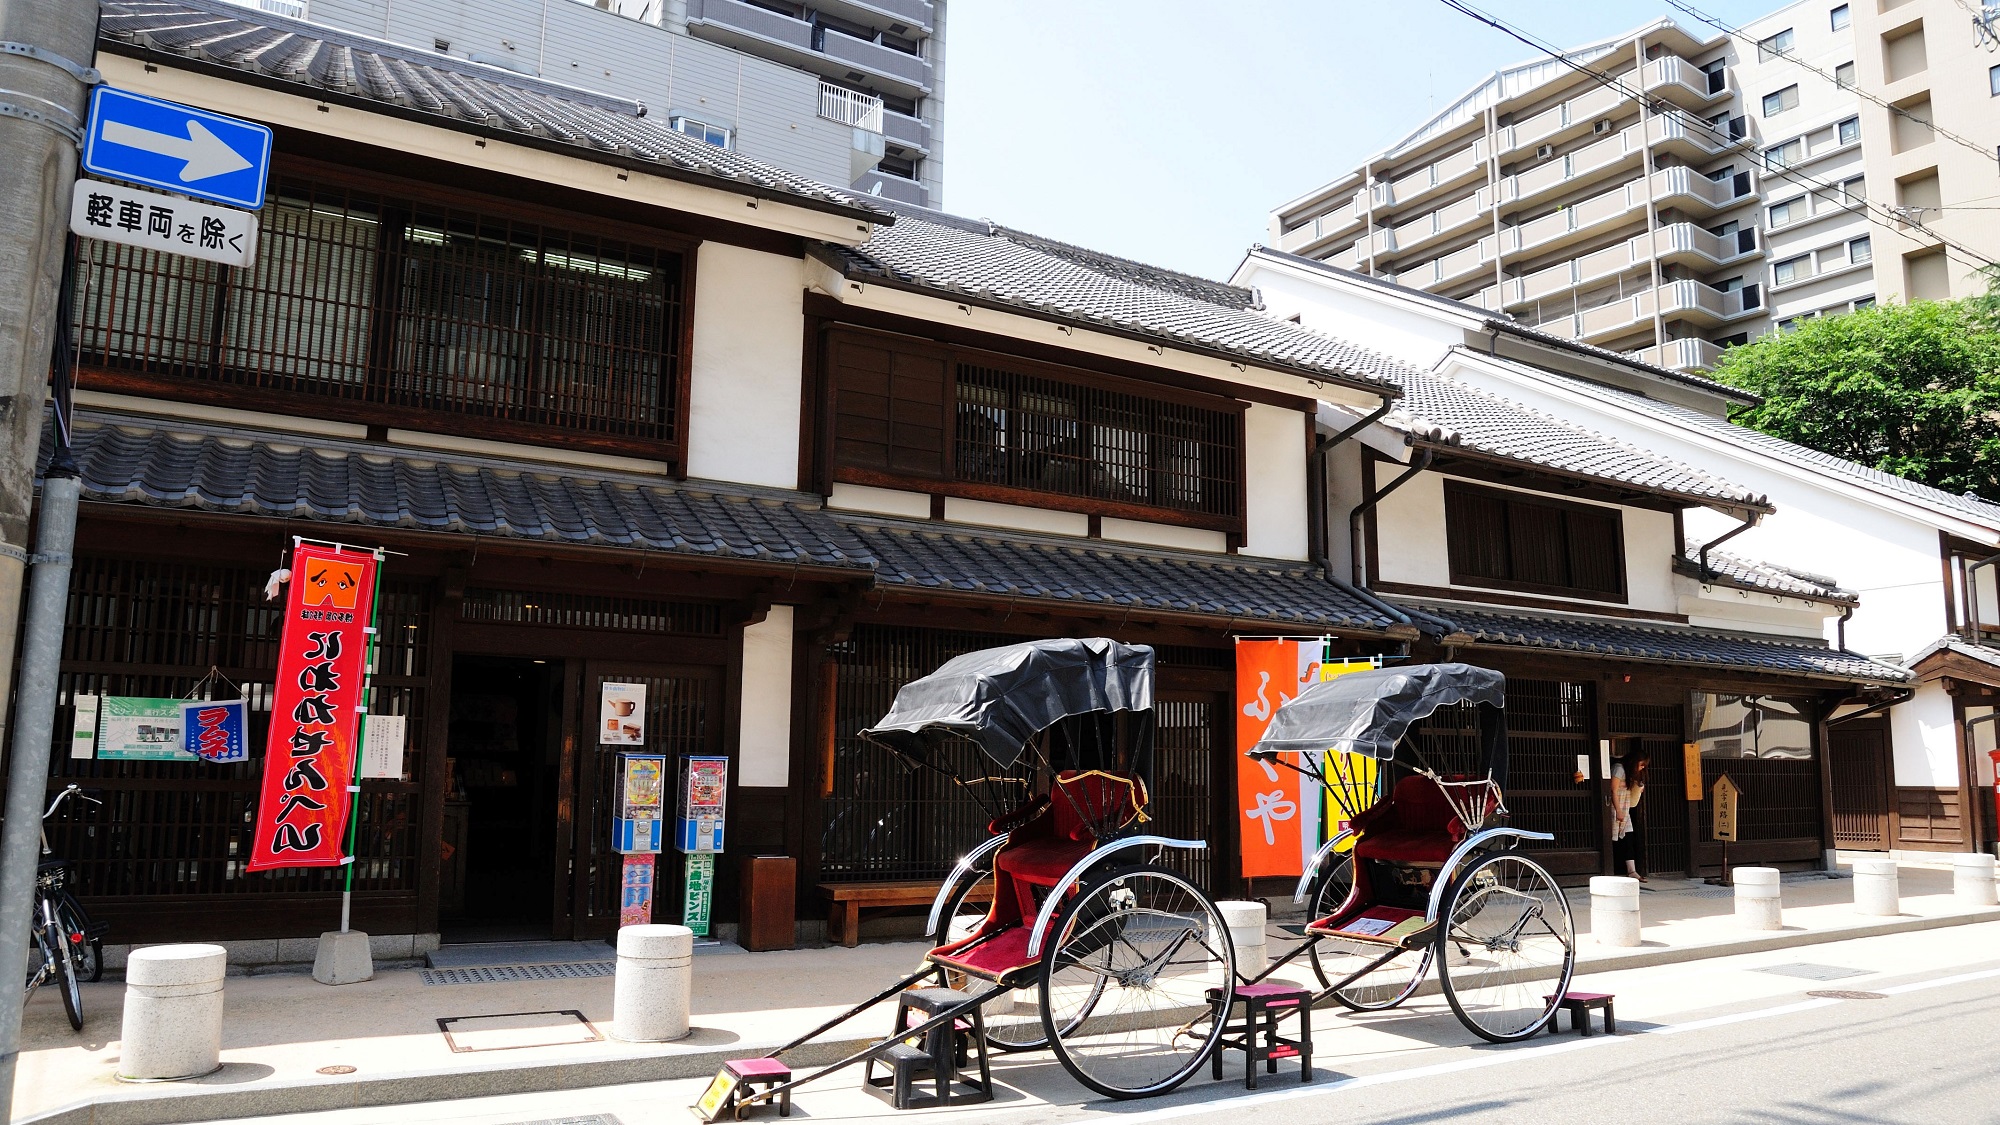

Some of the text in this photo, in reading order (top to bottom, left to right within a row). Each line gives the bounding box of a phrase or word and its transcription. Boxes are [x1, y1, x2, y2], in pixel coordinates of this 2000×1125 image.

[86, 192, 244, 254] 軽車両を除く
[197, 705, 230, 758] ラムネ
